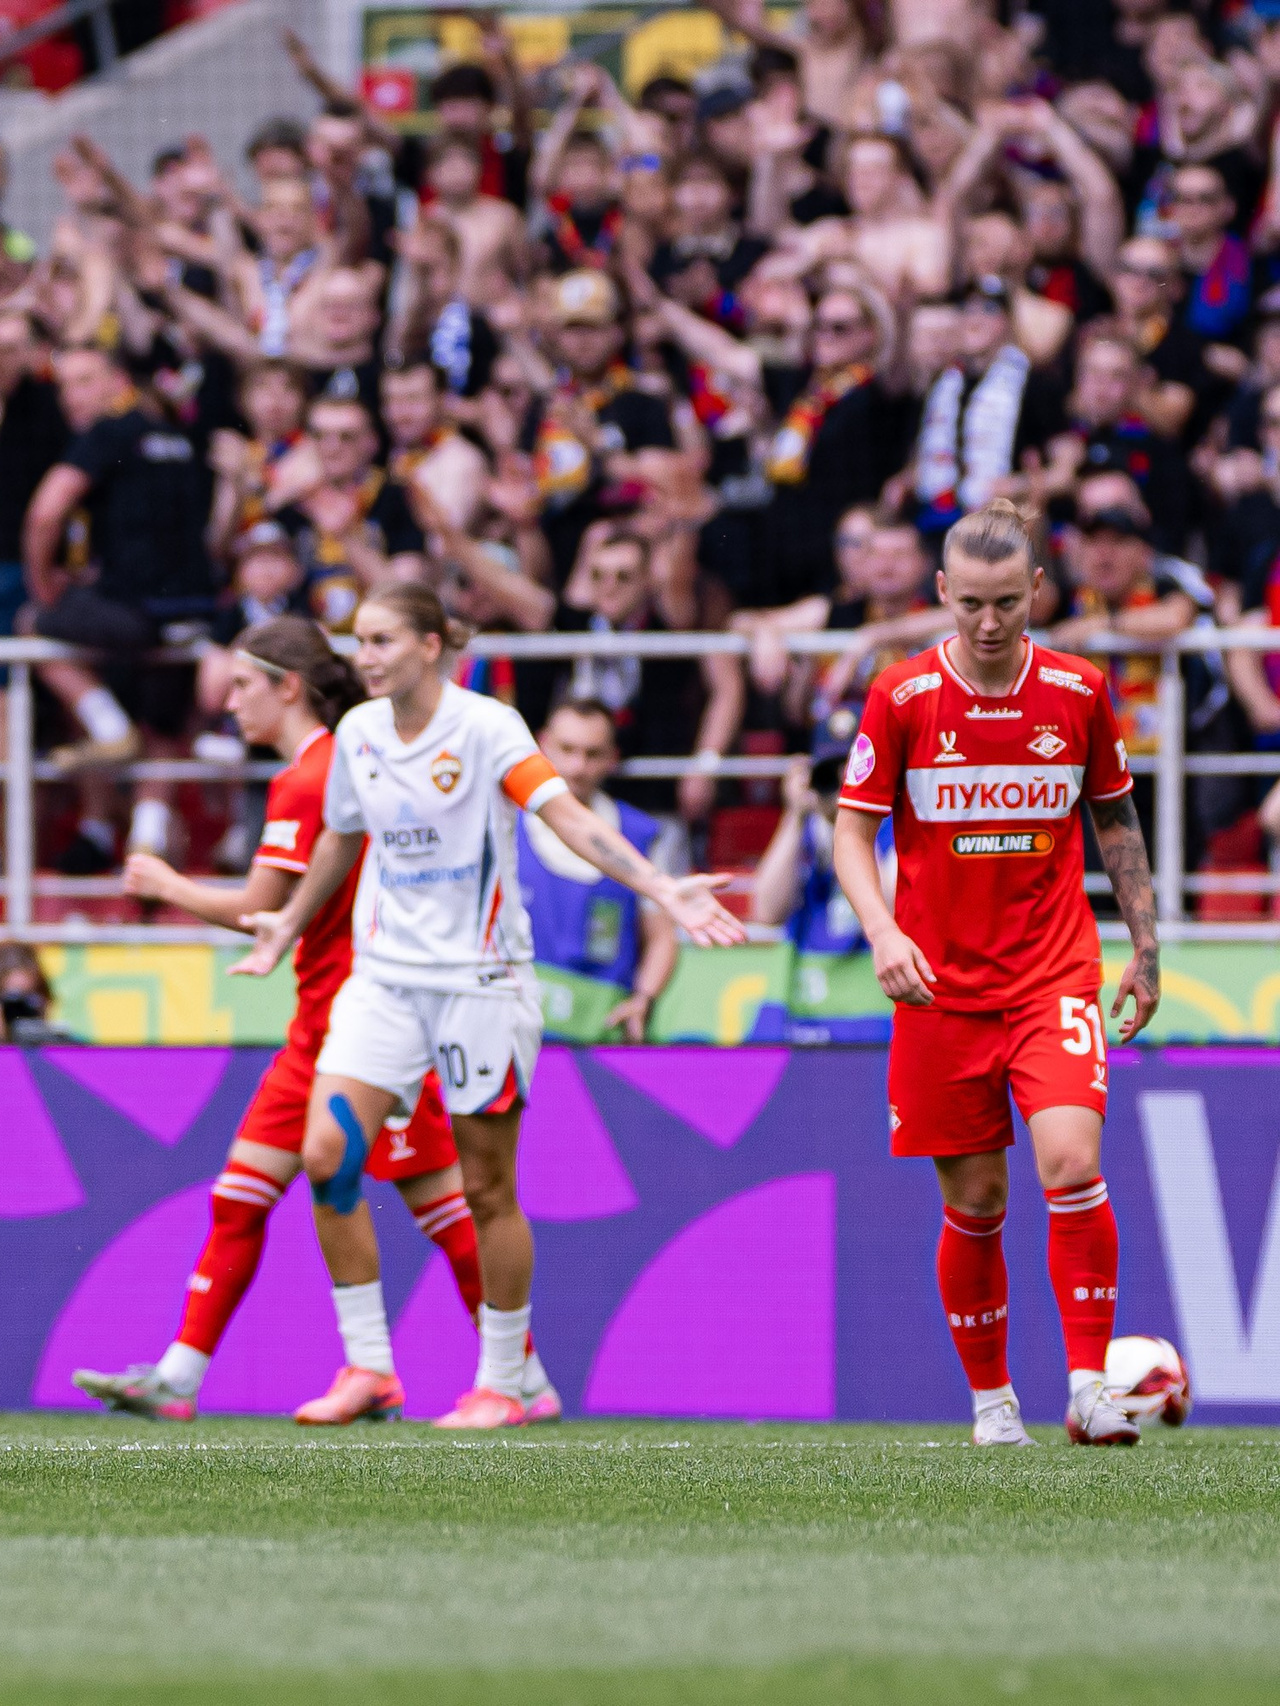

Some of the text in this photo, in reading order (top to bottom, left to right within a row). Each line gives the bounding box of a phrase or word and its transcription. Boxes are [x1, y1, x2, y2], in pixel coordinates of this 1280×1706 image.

[936, 776, 1068, 810] ЛУКОЙЛ
[957, 835, 1032, 853] WINLINE
[1060, 996, 1105, 1062] 51
[438, 1043, 467, 1088] 10
